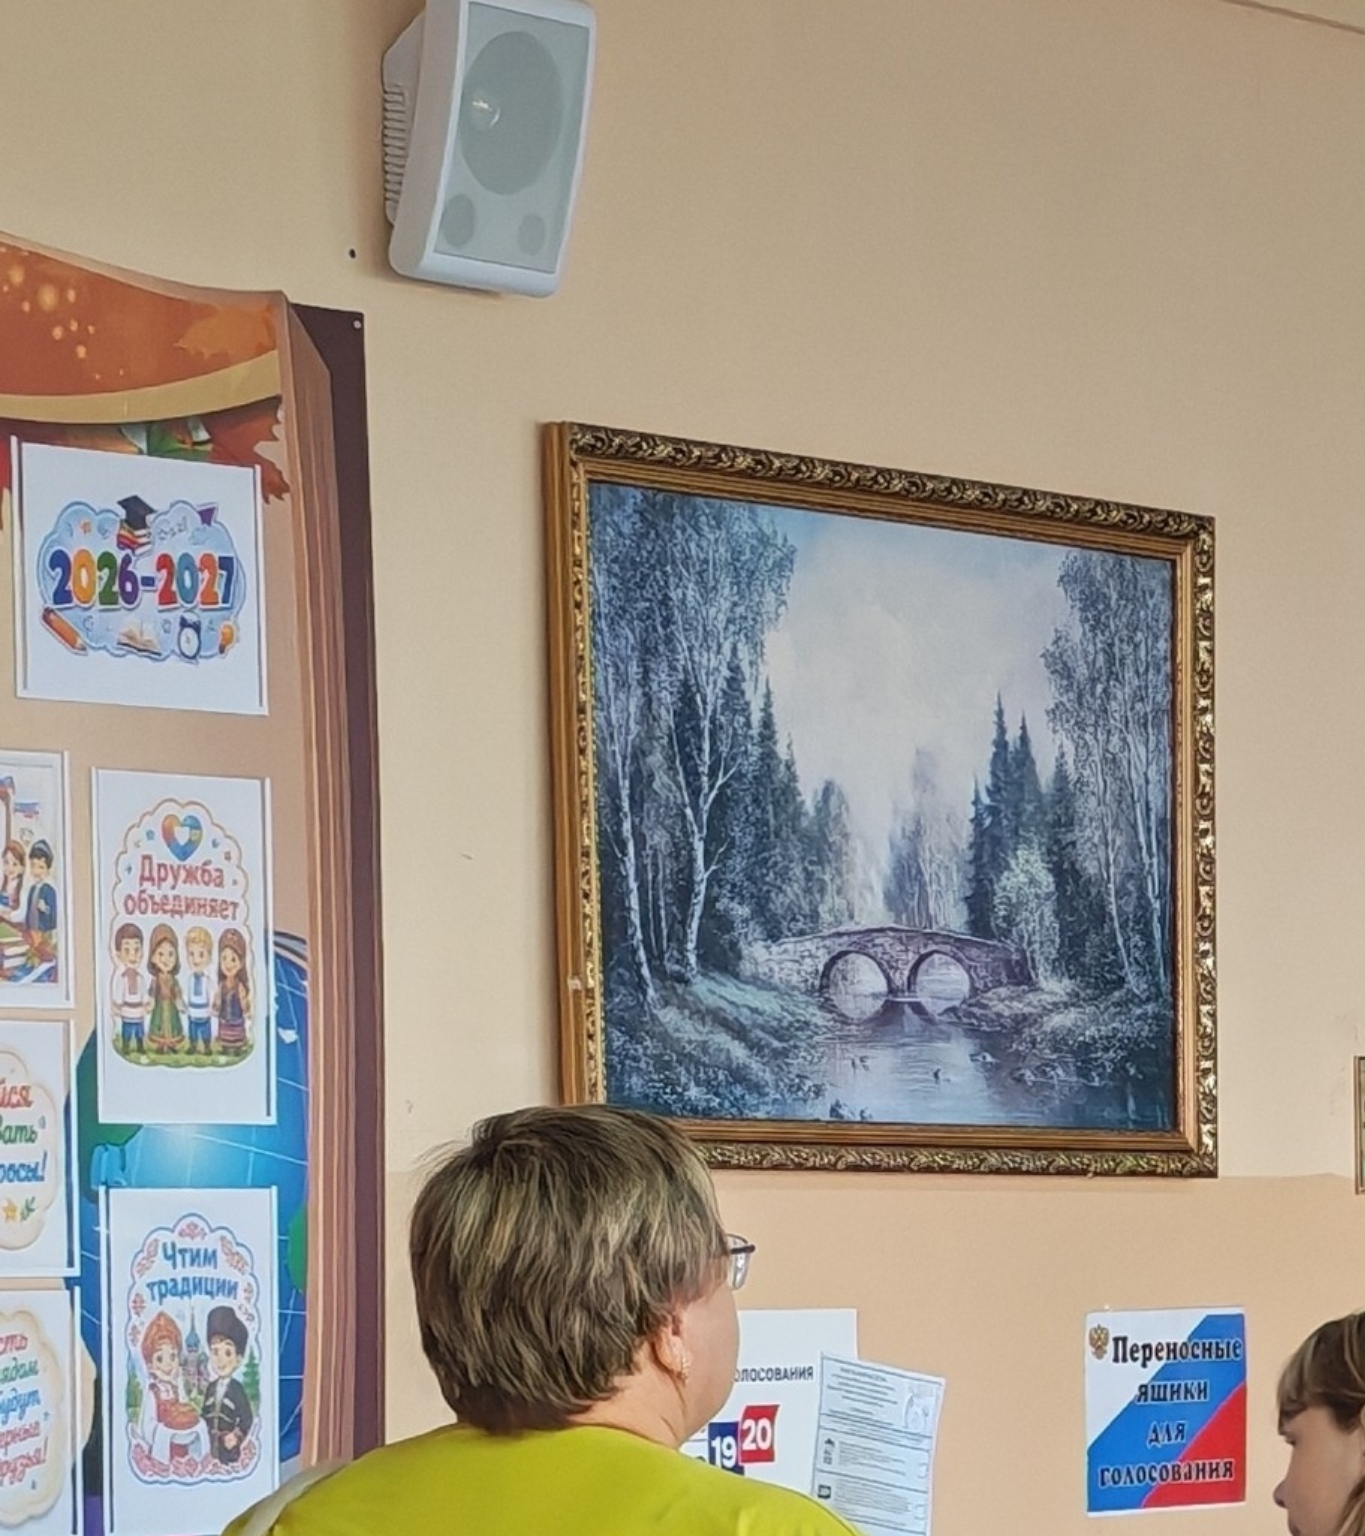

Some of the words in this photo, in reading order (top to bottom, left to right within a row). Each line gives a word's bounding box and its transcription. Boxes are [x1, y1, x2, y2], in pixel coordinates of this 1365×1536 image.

[48, 548, 235, 606] 2026-2027
[139, 854, 225, 890] Дружба
[123, 889, 240, 921] объединяет
[161, 1240, 218, 1270] Чтим
[145, 1276, 239, 1306] традиции
[1111, 1336, 1242, 1368] Переносные
[742, 1417, 773, 1452] 20
[1148, 1421, 1186, 1447] для
[711, 1435, 738, 1469] 19
[1099, 1459, 1234, 1487] голосования
